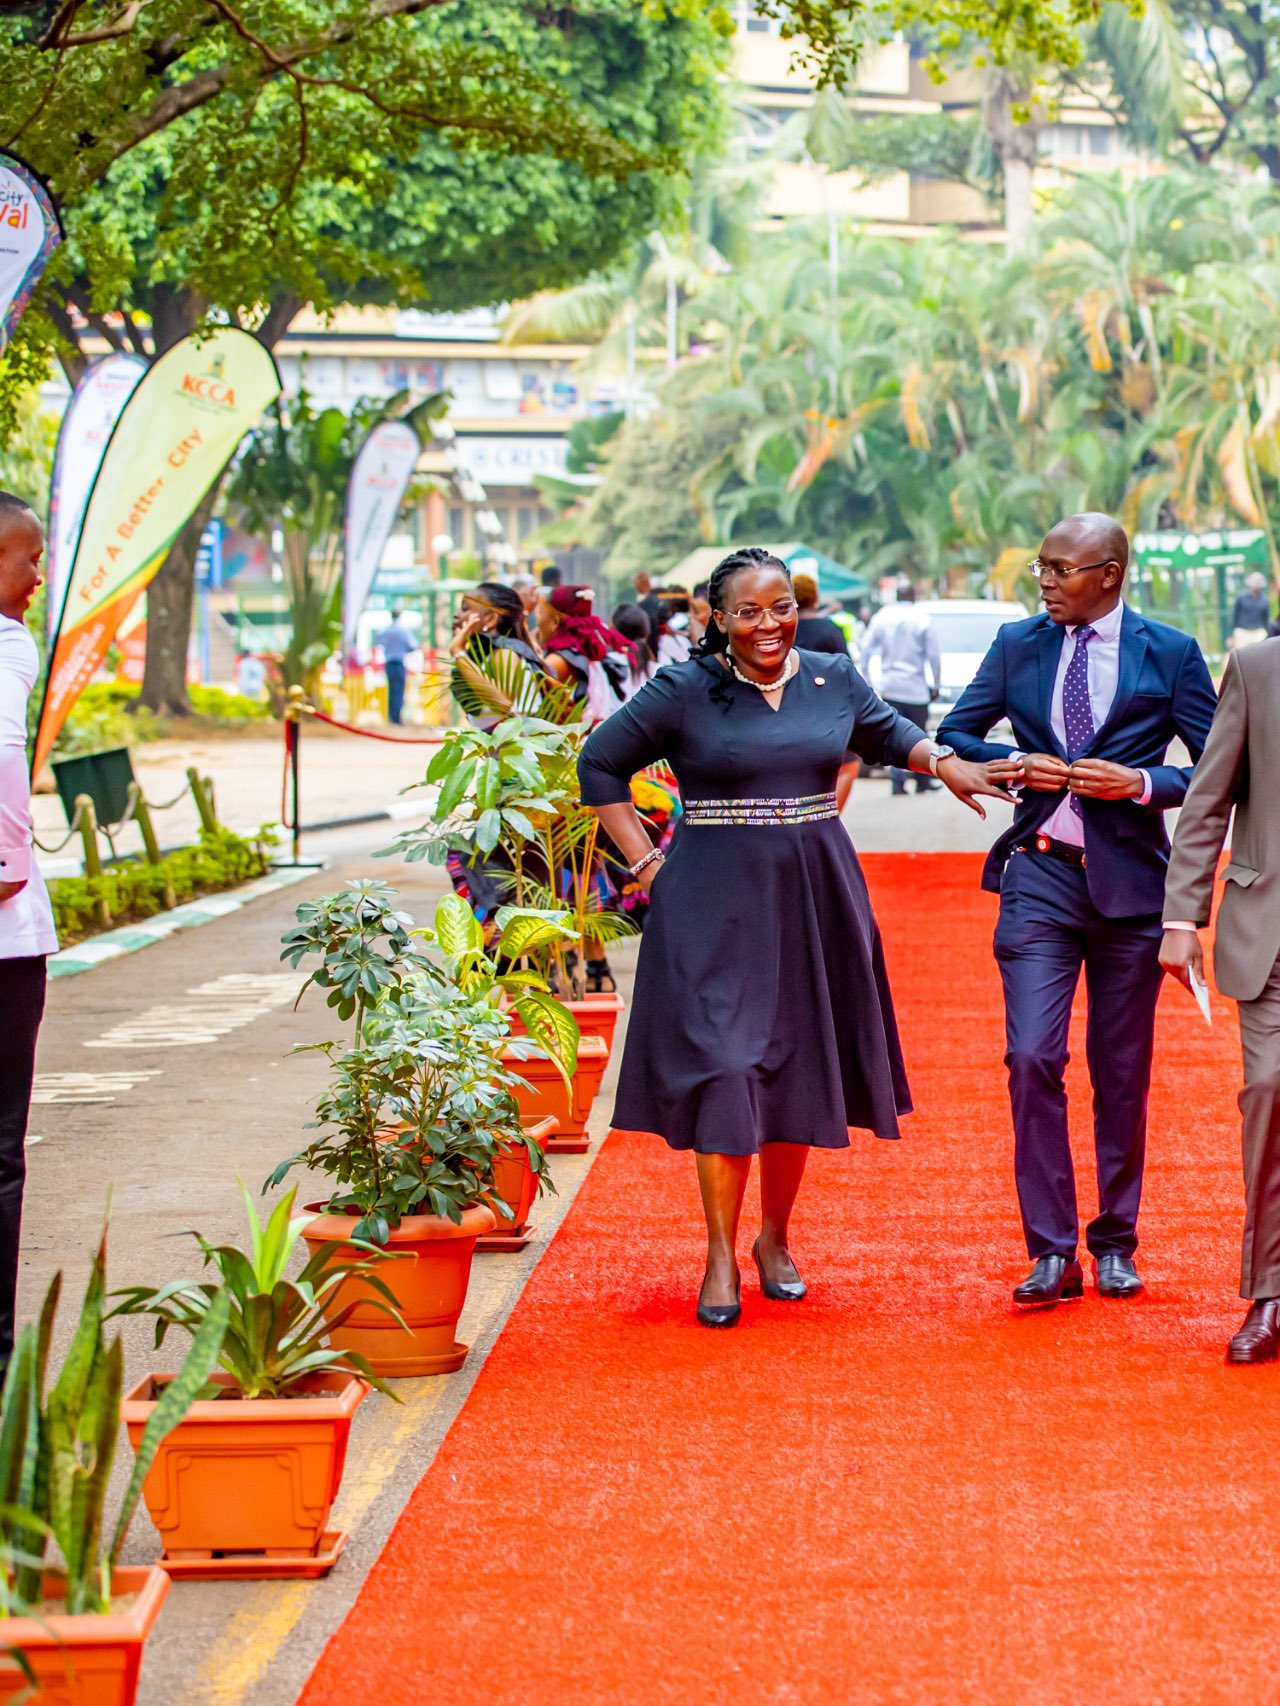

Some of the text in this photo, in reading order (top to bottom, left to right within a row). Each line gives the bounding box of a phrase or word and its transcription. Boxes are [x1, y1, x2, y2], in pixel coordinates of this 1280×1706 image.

[182, 373, 236, 406] KCCA
[79, 565, 109, 603] For
[105, 545, 122, 561] A
[117, 477, 164, 541] Better
